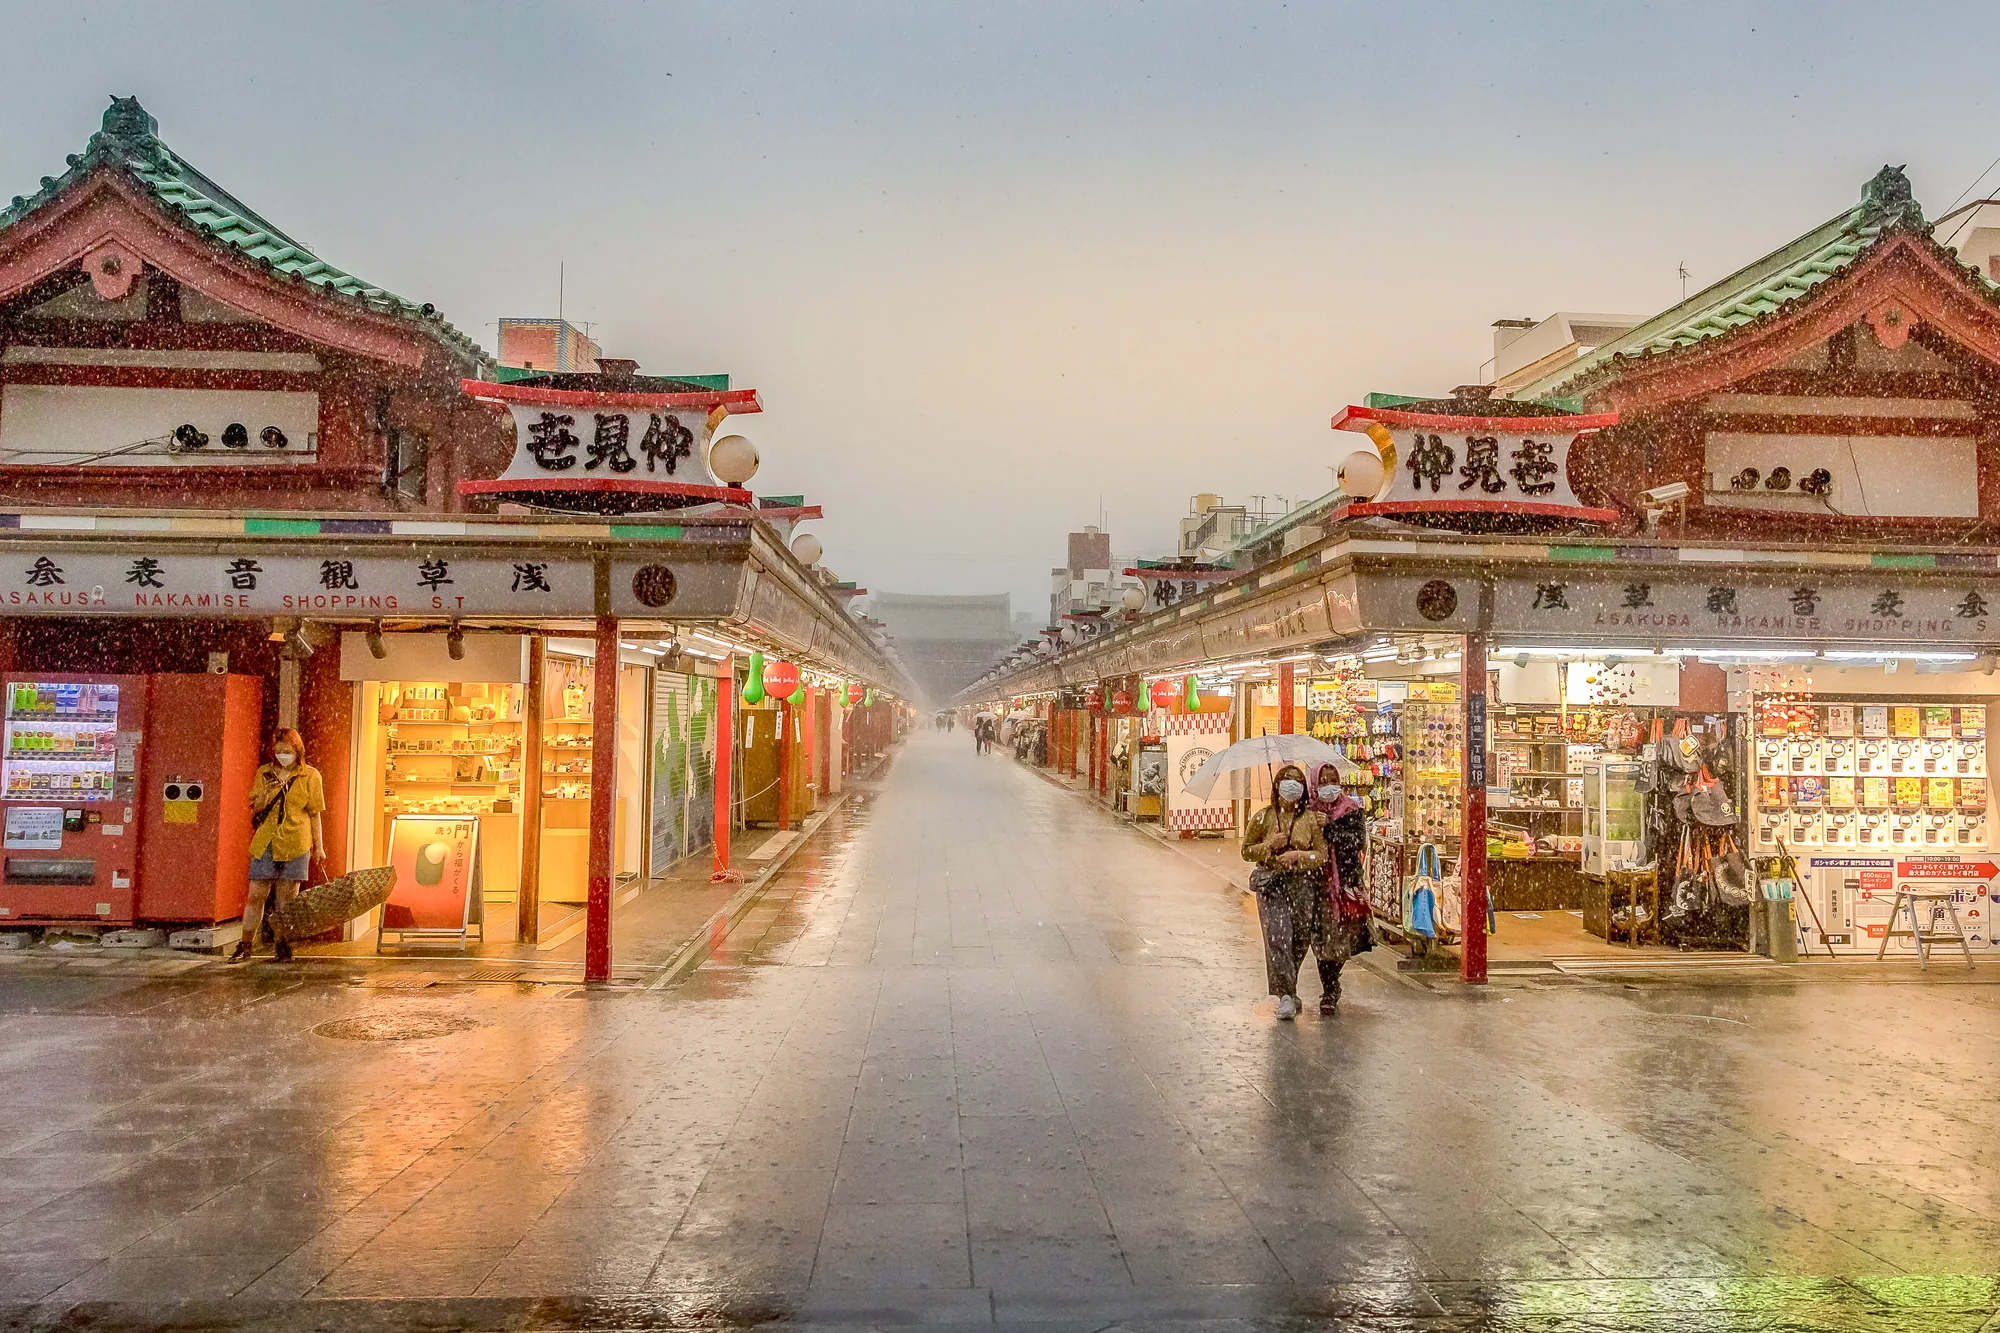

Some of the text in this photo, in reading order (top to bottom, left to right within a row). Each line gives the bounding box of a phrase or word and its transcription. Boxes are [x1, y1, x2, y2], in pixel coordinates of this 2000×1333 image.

[136, 593, 250, 608] NAKAMISE
[283, 594, 398, 610] SHOPPING
[1594, 613, 1691, 627] ASAKUSA
[1717, 615, 1822, 631] NAKAMISE
[1844, 619, 1953, 633] SHOPPING
